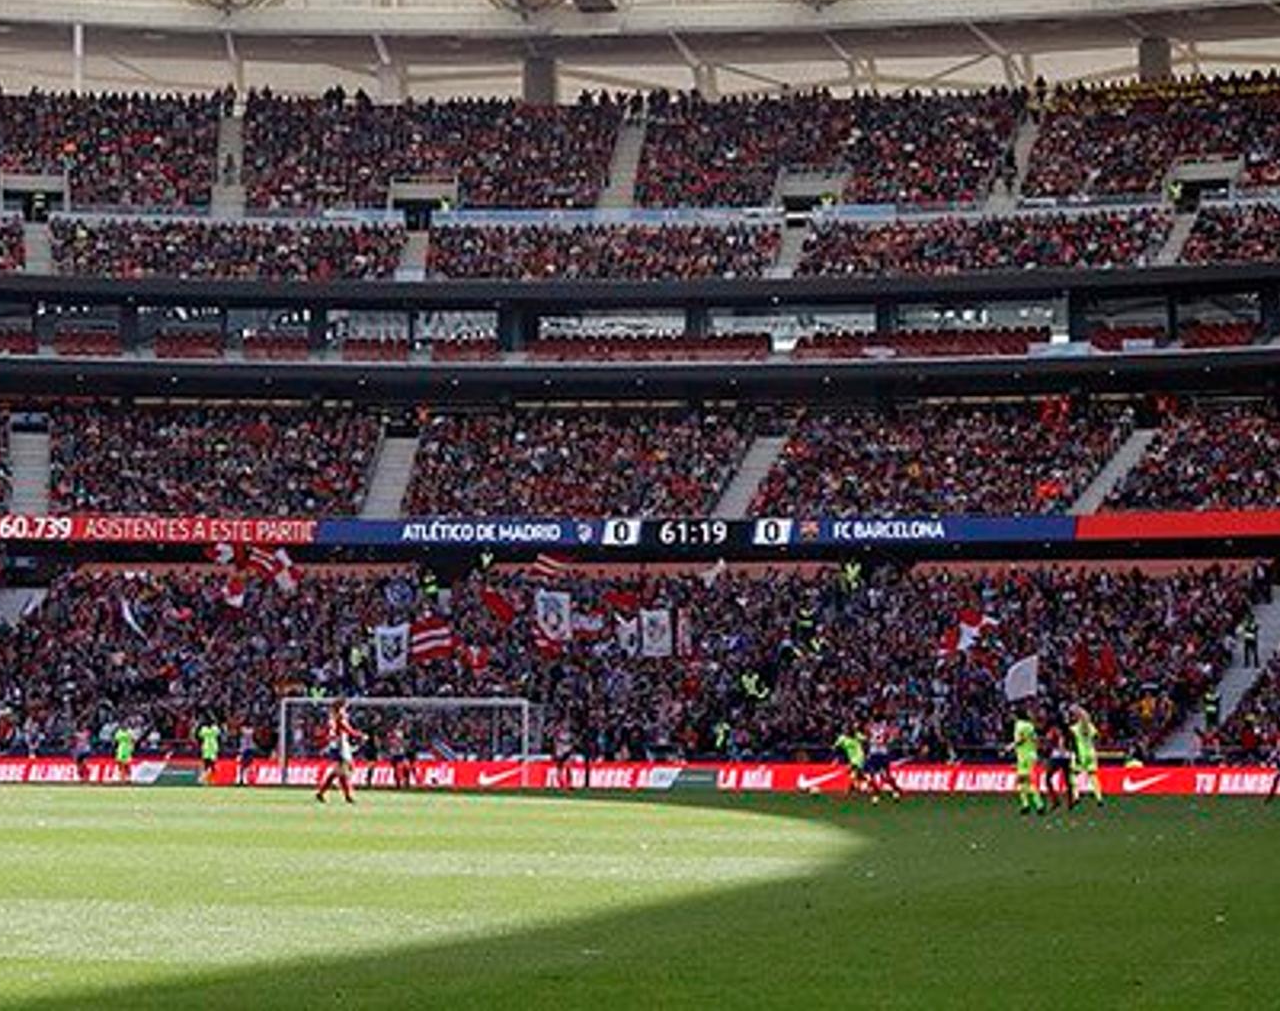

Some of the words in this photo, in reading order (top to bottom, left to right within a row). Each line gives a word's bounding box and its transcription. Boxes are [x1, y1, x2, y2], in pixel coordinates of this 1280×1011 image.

[0, 515, 72, 540] 60.739
[83, 517, 191, 541] ASISTENTES
[192, 519, 207, 541] A
[209, 520, 254, 542] ESTE
[402, 521, 475, 541] ATLÉTICO
[476, 524, 497, 541] DE
[498, 524, 561, 541] MADRID
[613, 520, 630, 542] 0
[660, 521, 728, 544] 61:19
[763, 520, 780, 542] 0
[832, 521, 852, 539] FC
[853, 521, 946, 539] BARCELONA
[716, 769, 737, 789] LA
[740, 764, 773, 789] MÍA
[1194, 774, 1217, 795] TU
